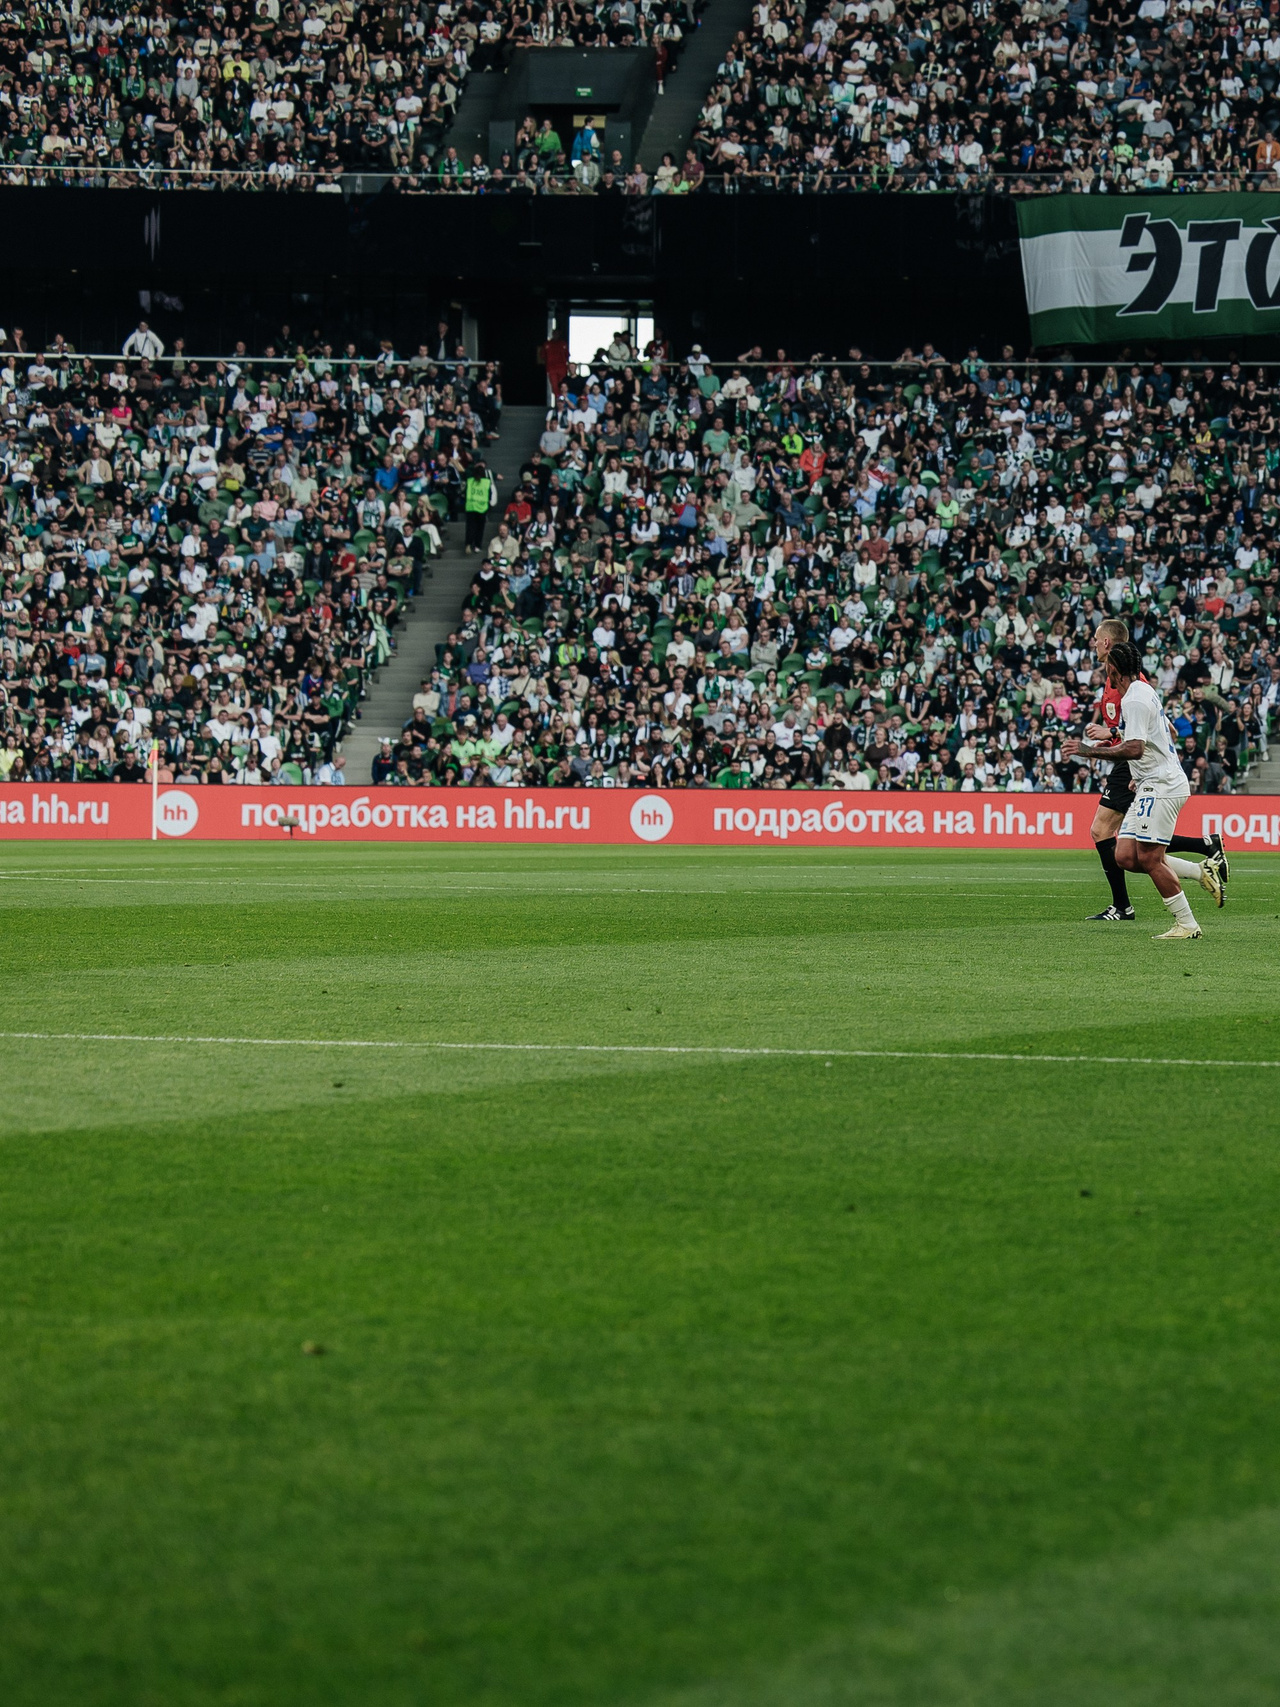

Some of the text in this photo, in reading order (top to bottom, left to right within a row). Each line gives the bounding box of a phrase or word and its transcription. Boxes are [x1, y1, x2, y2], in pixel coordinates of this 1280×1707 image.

[32, 793, 109, 825] hh.ru
[163, 805, 188, 821] hh
[241, 796, 590, 835] подработка на hh.ru
[640, 809, 664, 826] hh
[713, 801, 1073, 839] подработка на hh.ru
[1136, 797, 1155, 818] 37
